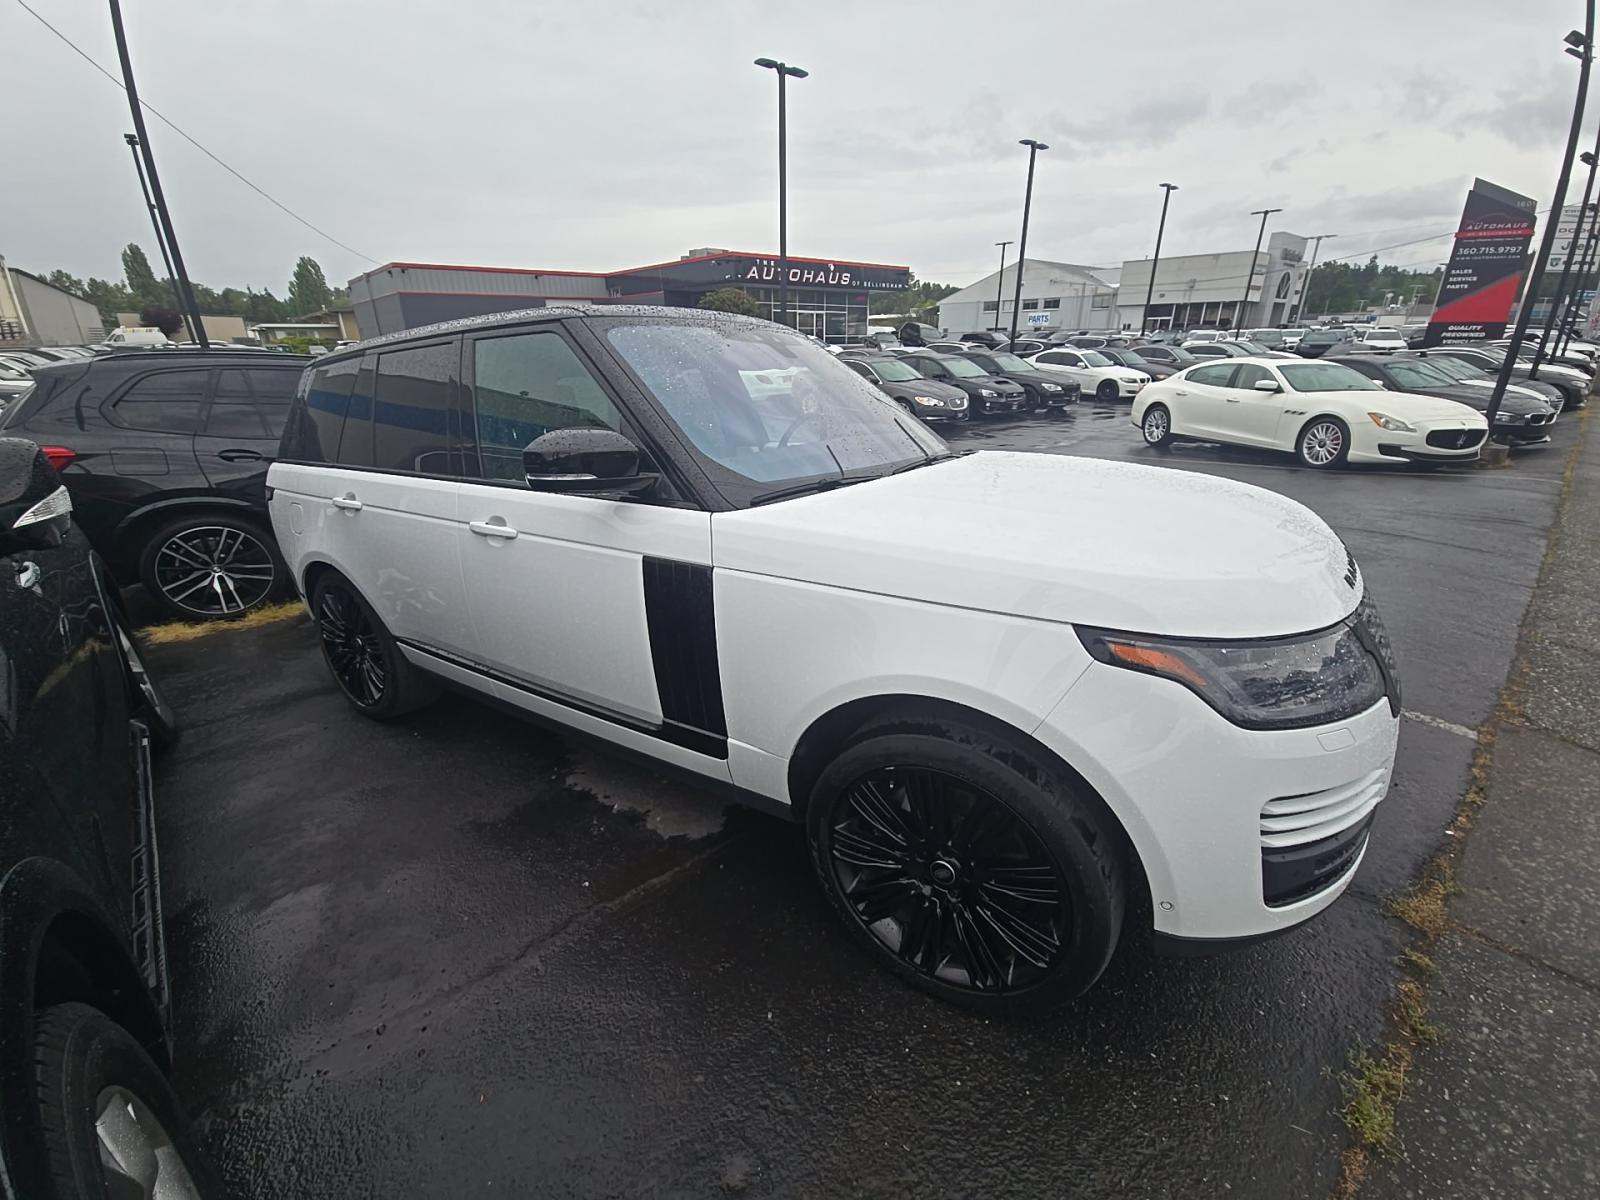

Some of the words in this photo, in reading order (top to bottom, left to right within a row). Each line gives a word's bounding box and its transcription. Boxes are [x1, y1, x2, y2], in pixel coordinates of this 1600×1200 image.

[1466, 222, 1529, 231] AUTOHAUS
[1457, 246, 1523, 256] 360.715.9797
[747, 265, 851, 285] AUOHAUS
[1028, 314, 1049, 323] PARTS
